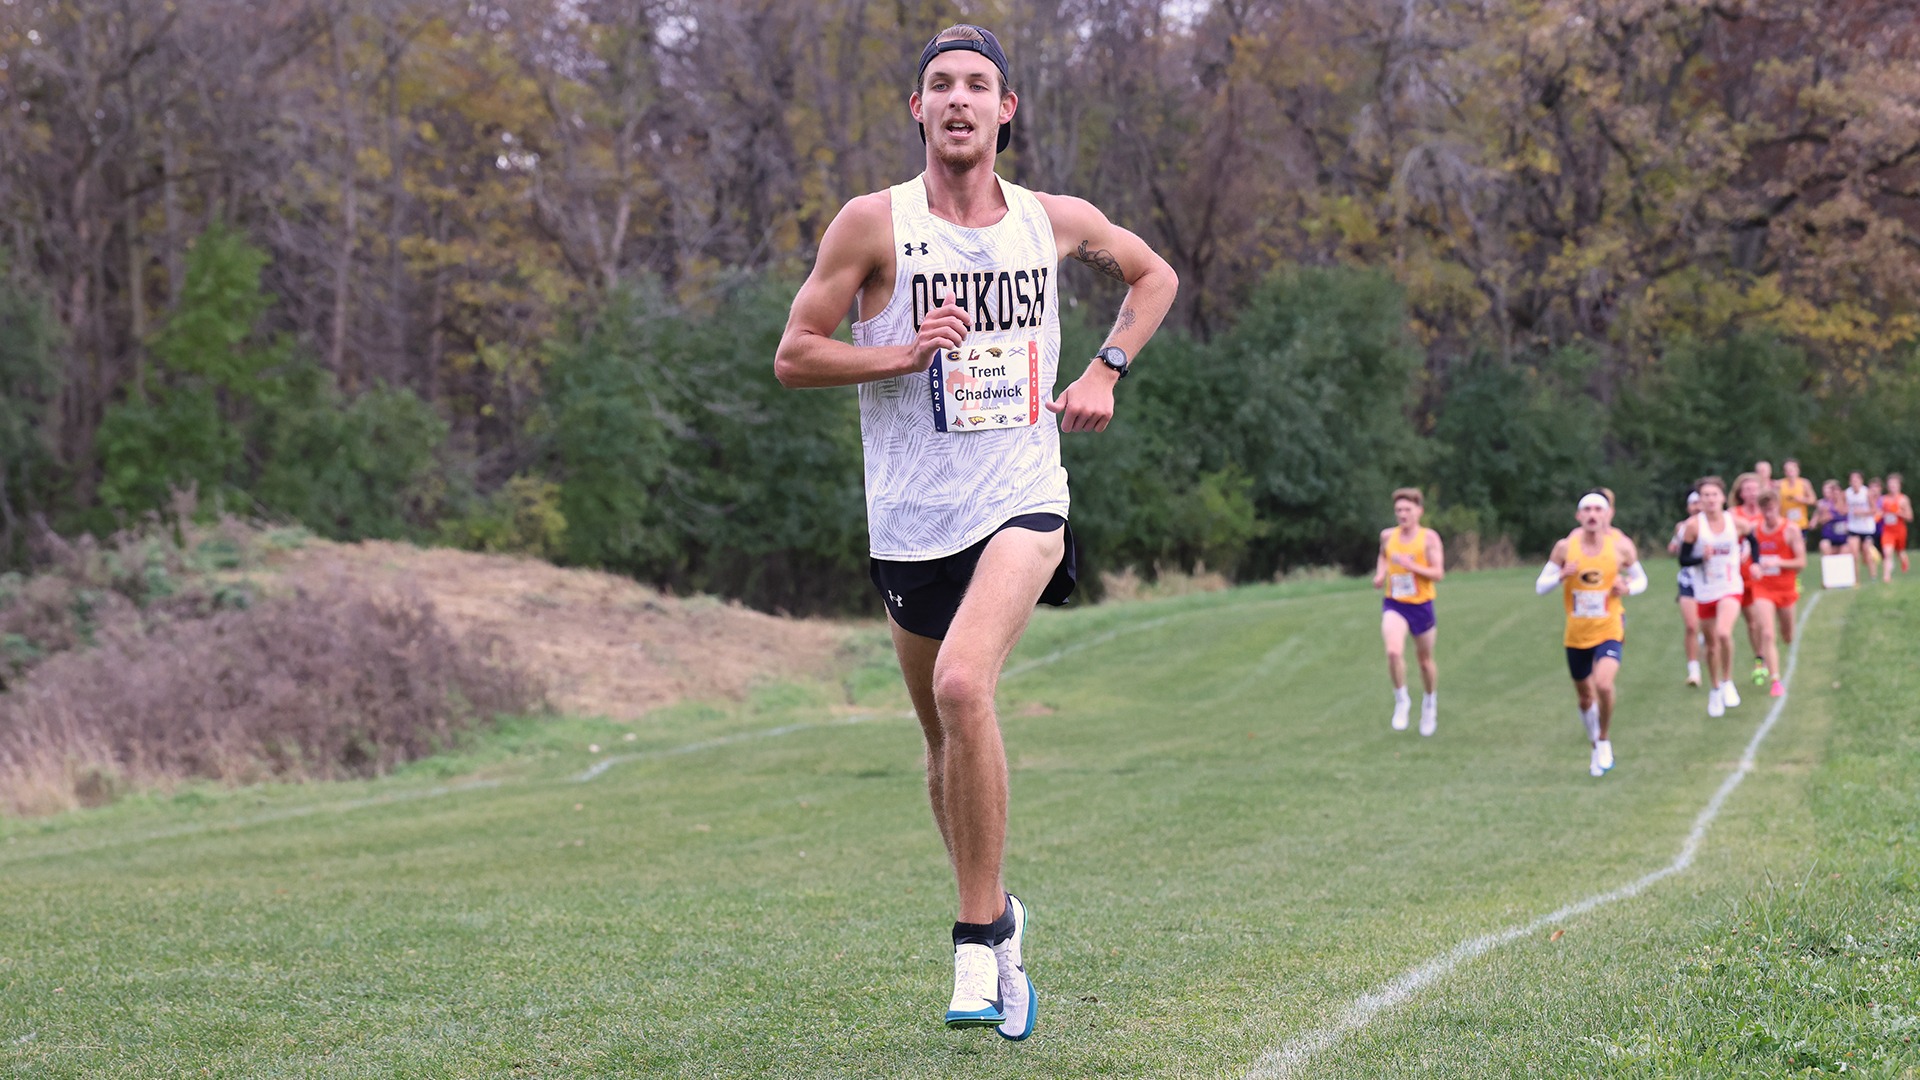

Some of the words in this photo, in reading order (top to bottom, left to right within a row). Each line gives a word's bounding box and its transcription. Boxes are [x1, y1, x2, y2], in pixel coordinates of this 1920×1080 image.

[969, 365, 1006, 378] Trent
[932, 369, 941, 412] 2025
[954, 385, 1022, 401] Chadwick
